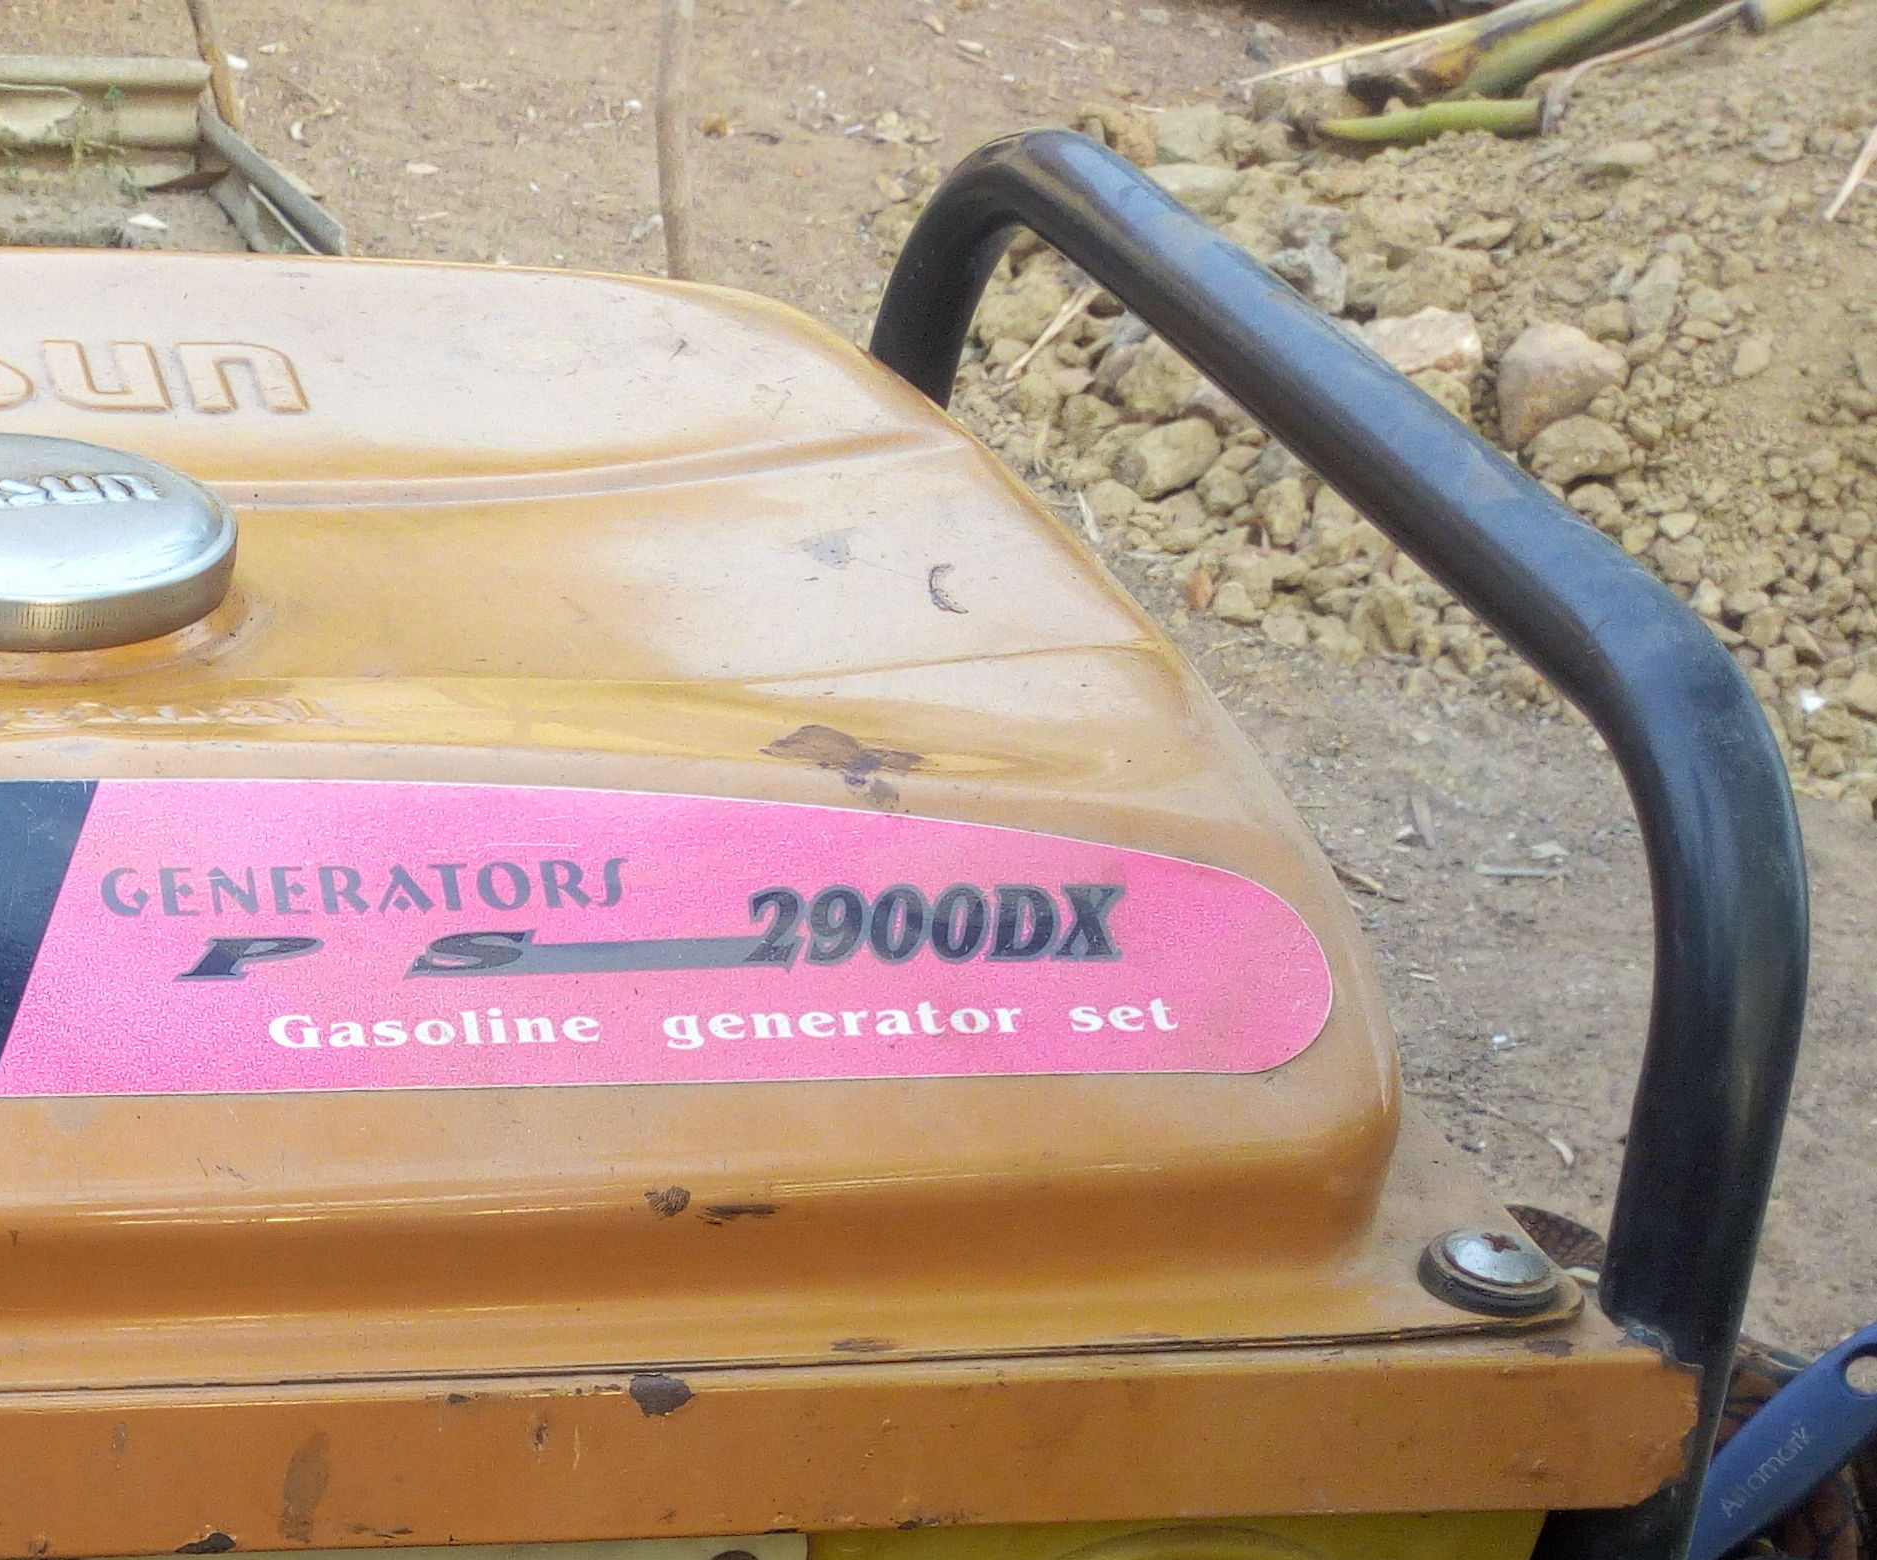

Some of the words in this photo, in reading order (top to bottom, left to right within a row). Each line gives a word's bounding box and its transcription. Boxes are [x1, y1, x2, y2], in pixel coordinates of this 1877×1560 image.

[99, 857, 630, 920] GENERATORS
[746, 883, 1129, 967] 2900DX
[268, 1005, 602, 1050] Gasoline
[662, 998, 1025, 1046] generator
[1069, 996, 1180, 1036] set
